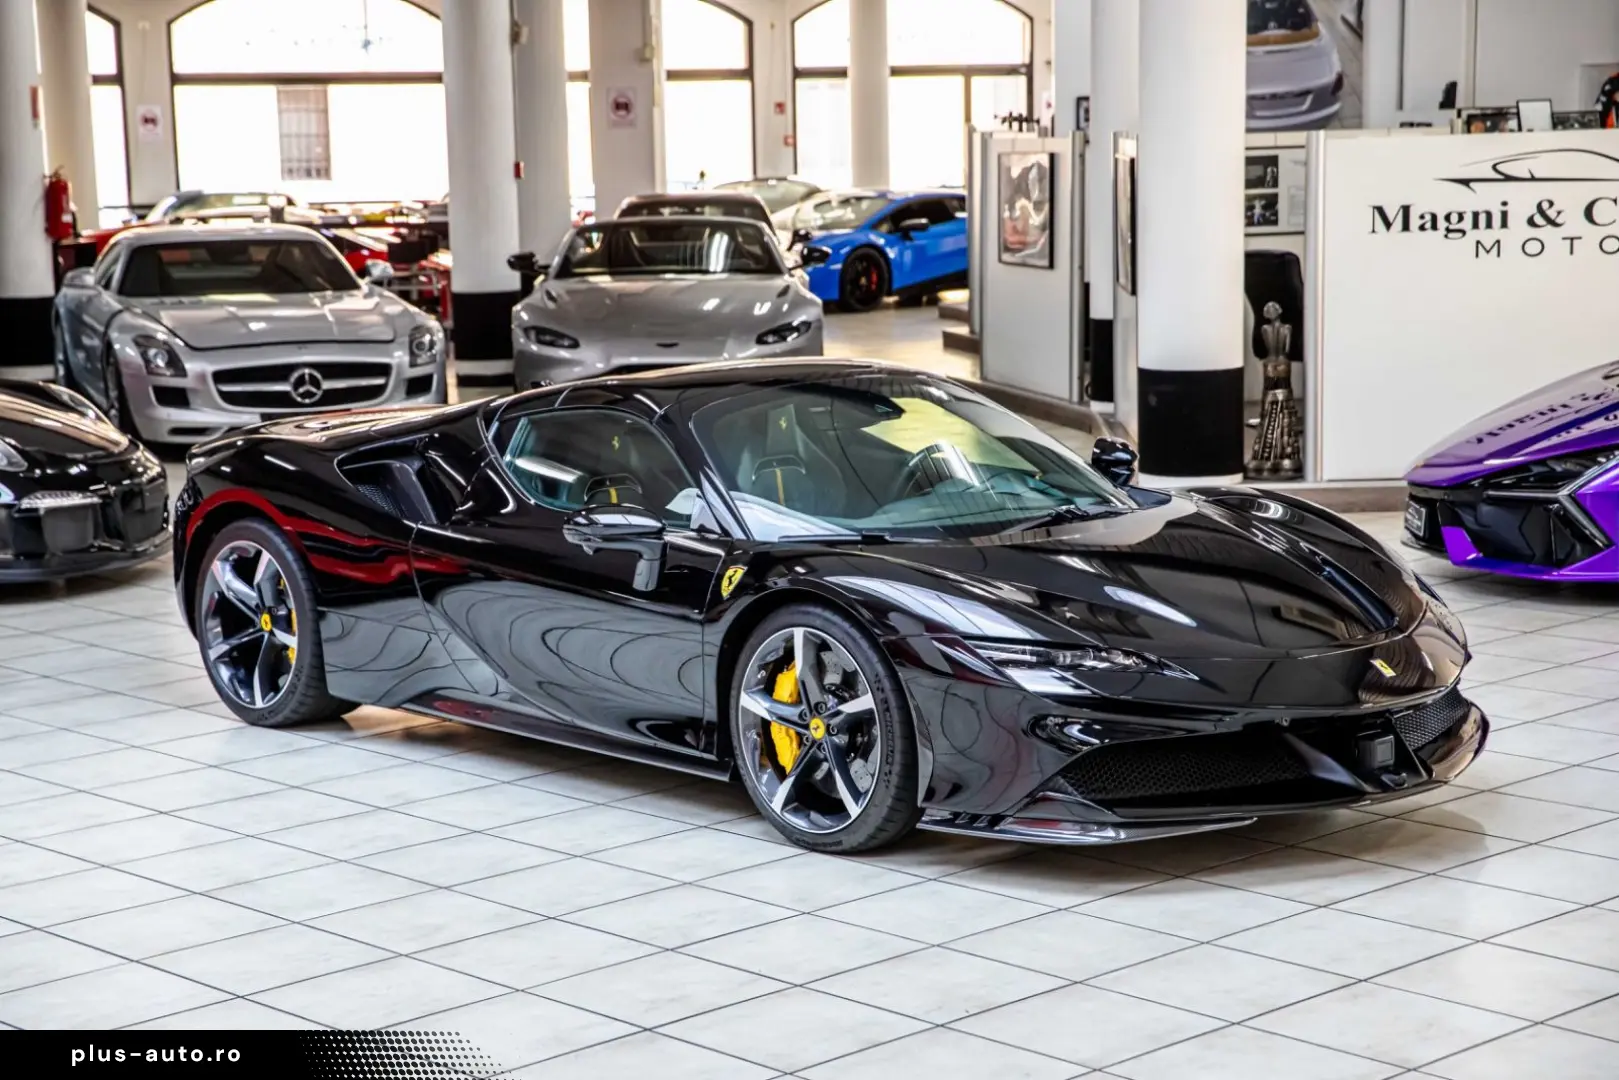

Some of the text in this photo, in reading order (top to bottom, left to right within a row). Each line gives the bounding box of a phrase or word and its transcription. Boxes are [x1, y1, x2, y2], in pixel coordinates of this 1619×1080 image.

[1370, 196, 1618, 240] Magni & C
[1475, 234, 1619, 259] MOTO
